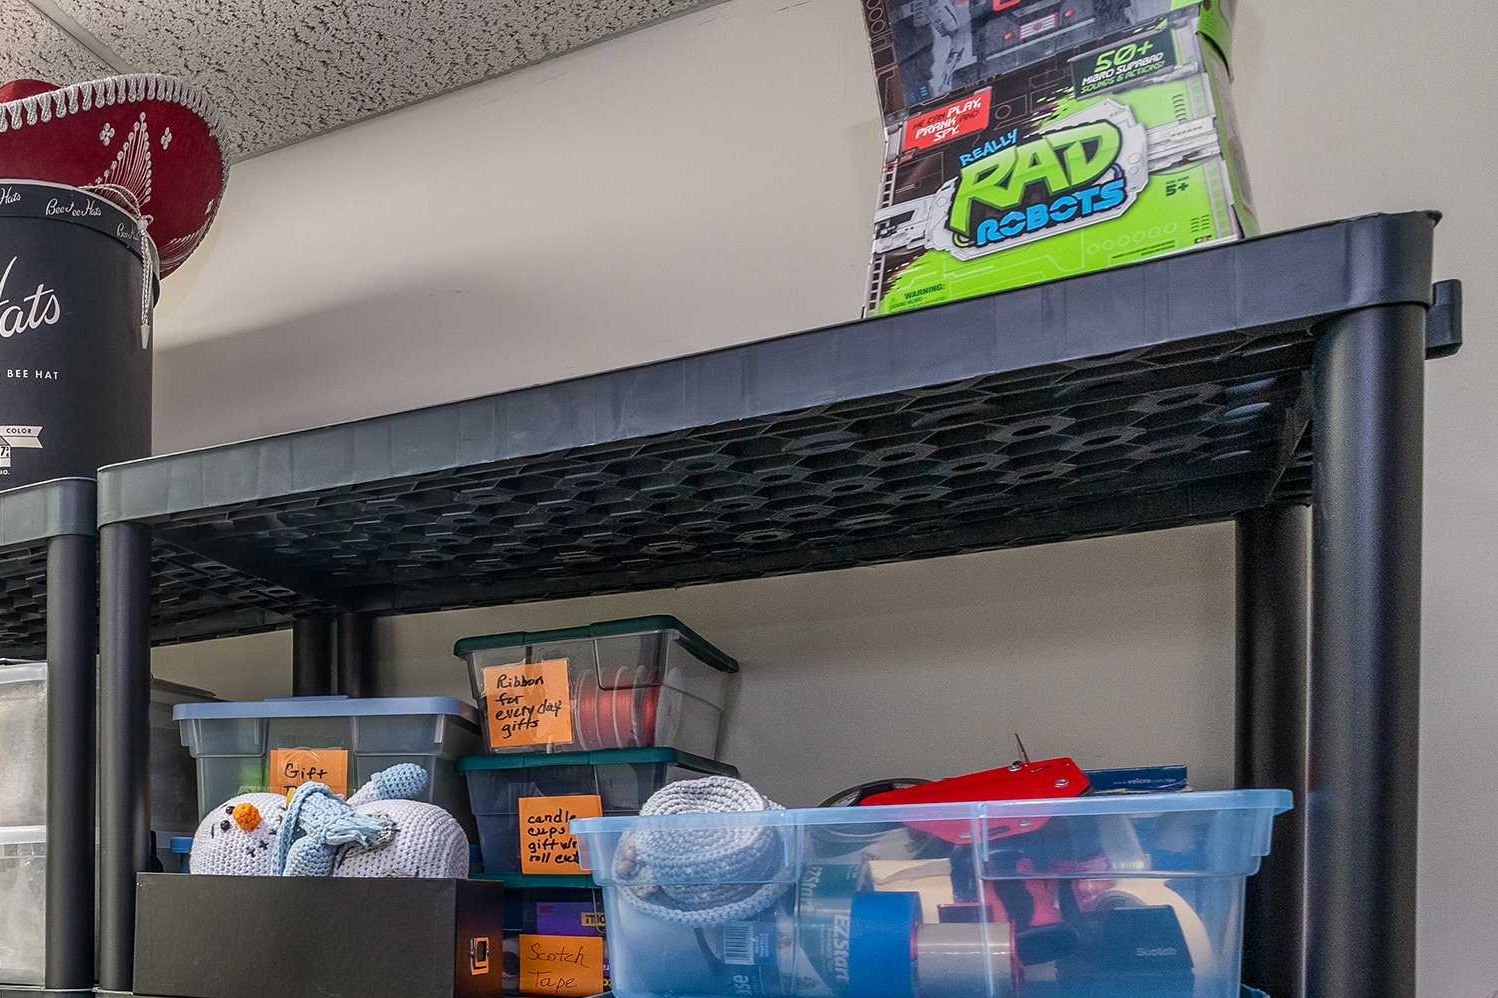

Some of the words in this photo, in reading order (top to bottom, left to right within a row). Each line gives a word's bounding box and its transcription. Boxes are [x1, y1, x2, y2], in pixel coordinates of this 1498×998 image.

[1094, 40, 1153, 73] 50+
[1116, 52, 1164, 75] SUPABAD
[947, 97, 982, 118] PLAY,
[915, 117, 957, 139] PRANK
[933, 125, 960, 142] SPY.
[959, 128, 1018, 167] REALLY
[949, 119, 1122, 238] RAD
[976, 178, 1128, 247] ROBOTS
[904, 283, 946, 299] WARNING:
[6, 369, 29, 379] BEE
[35, 370, 60, 381] HAT
[6, 426, 32, 435] COLOR
[497, 674, 544, 689] Ribbon
[495, 692, 524, 706] for
[501, 718, 540, 739] gifts
[284, 763, 328, 779] Gift
[527, 808, 577, 824] candle
[527, 826, 566, 840] cups
[528, 838, 559, 853] gift
[529, 853, 551, 864] roll
[527, 942, 590, 968] Scotch
[1136, 947, 1177, 956] Scotch
[528, 970, 578, 994] Tape
